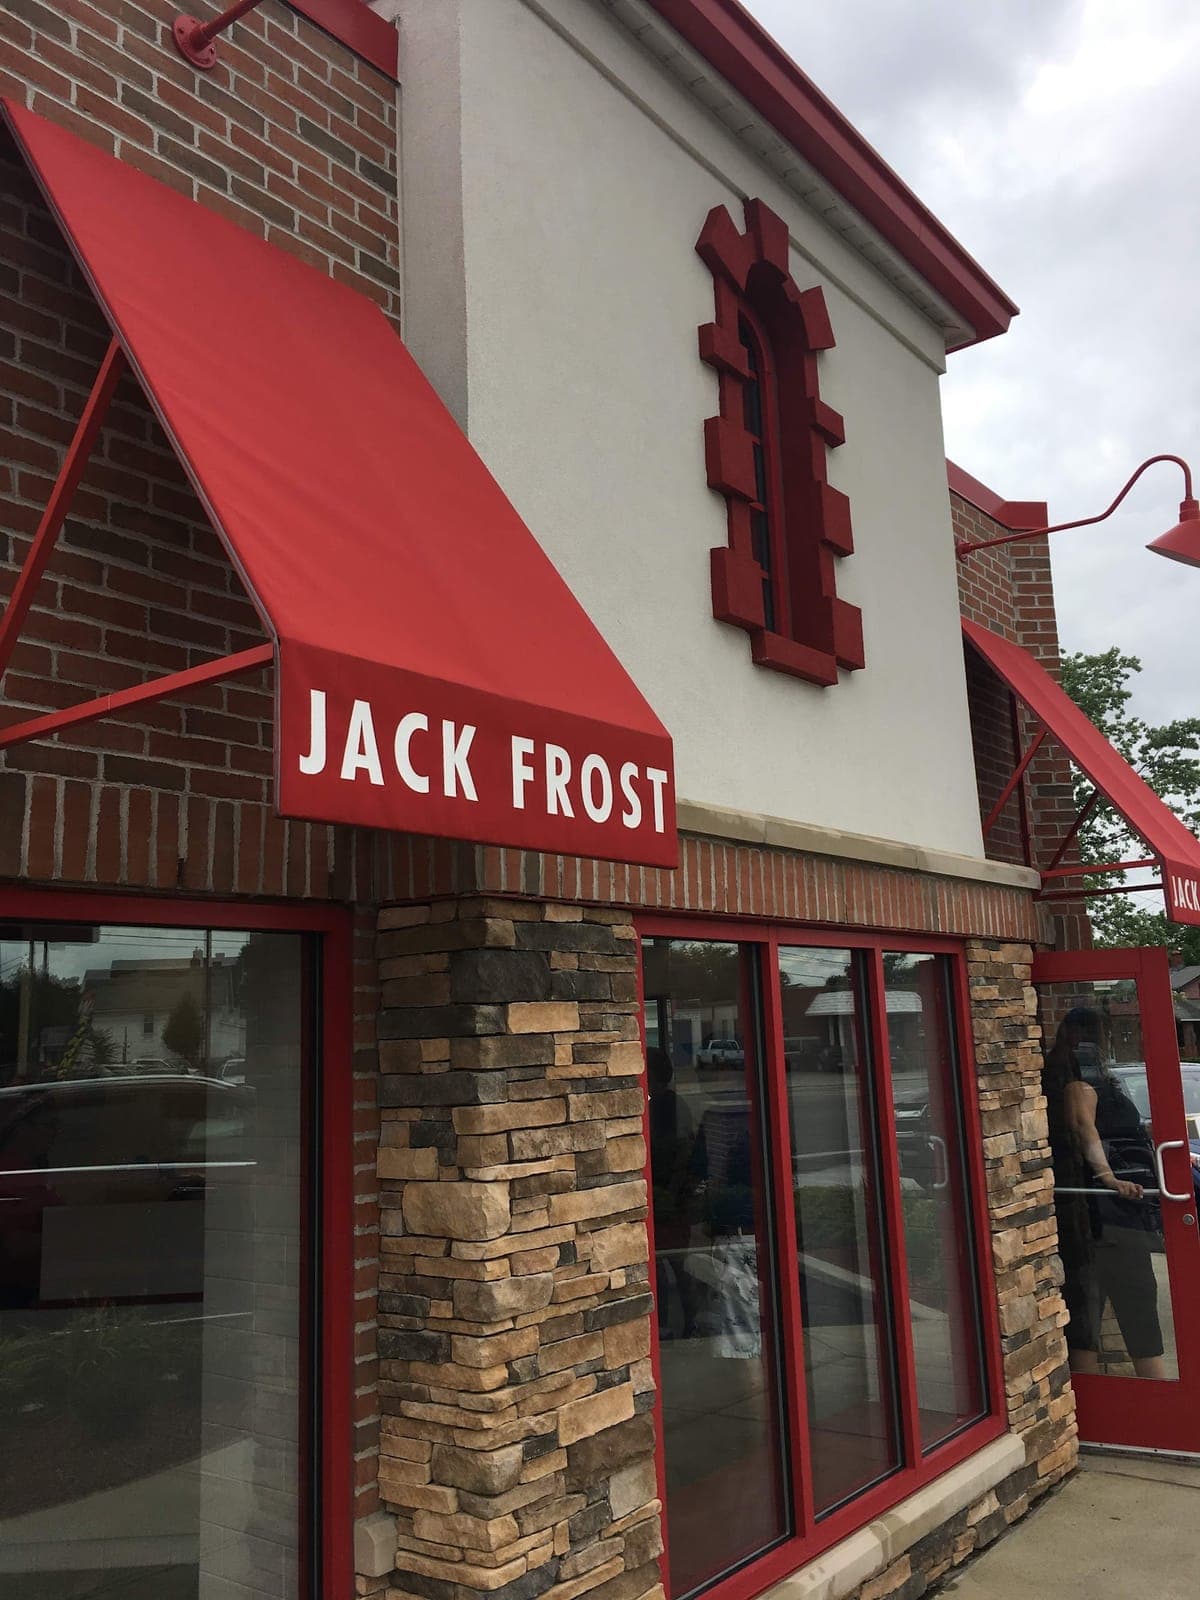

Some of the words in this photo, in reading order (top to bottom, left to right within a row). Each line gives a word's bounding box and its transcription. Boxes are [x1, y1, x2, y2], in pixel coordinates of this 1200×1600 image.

[299, 689, 479, 802] JACK
[511, 734, 669, 834] FROST
[1171, 875, 1200, 911] JACK
